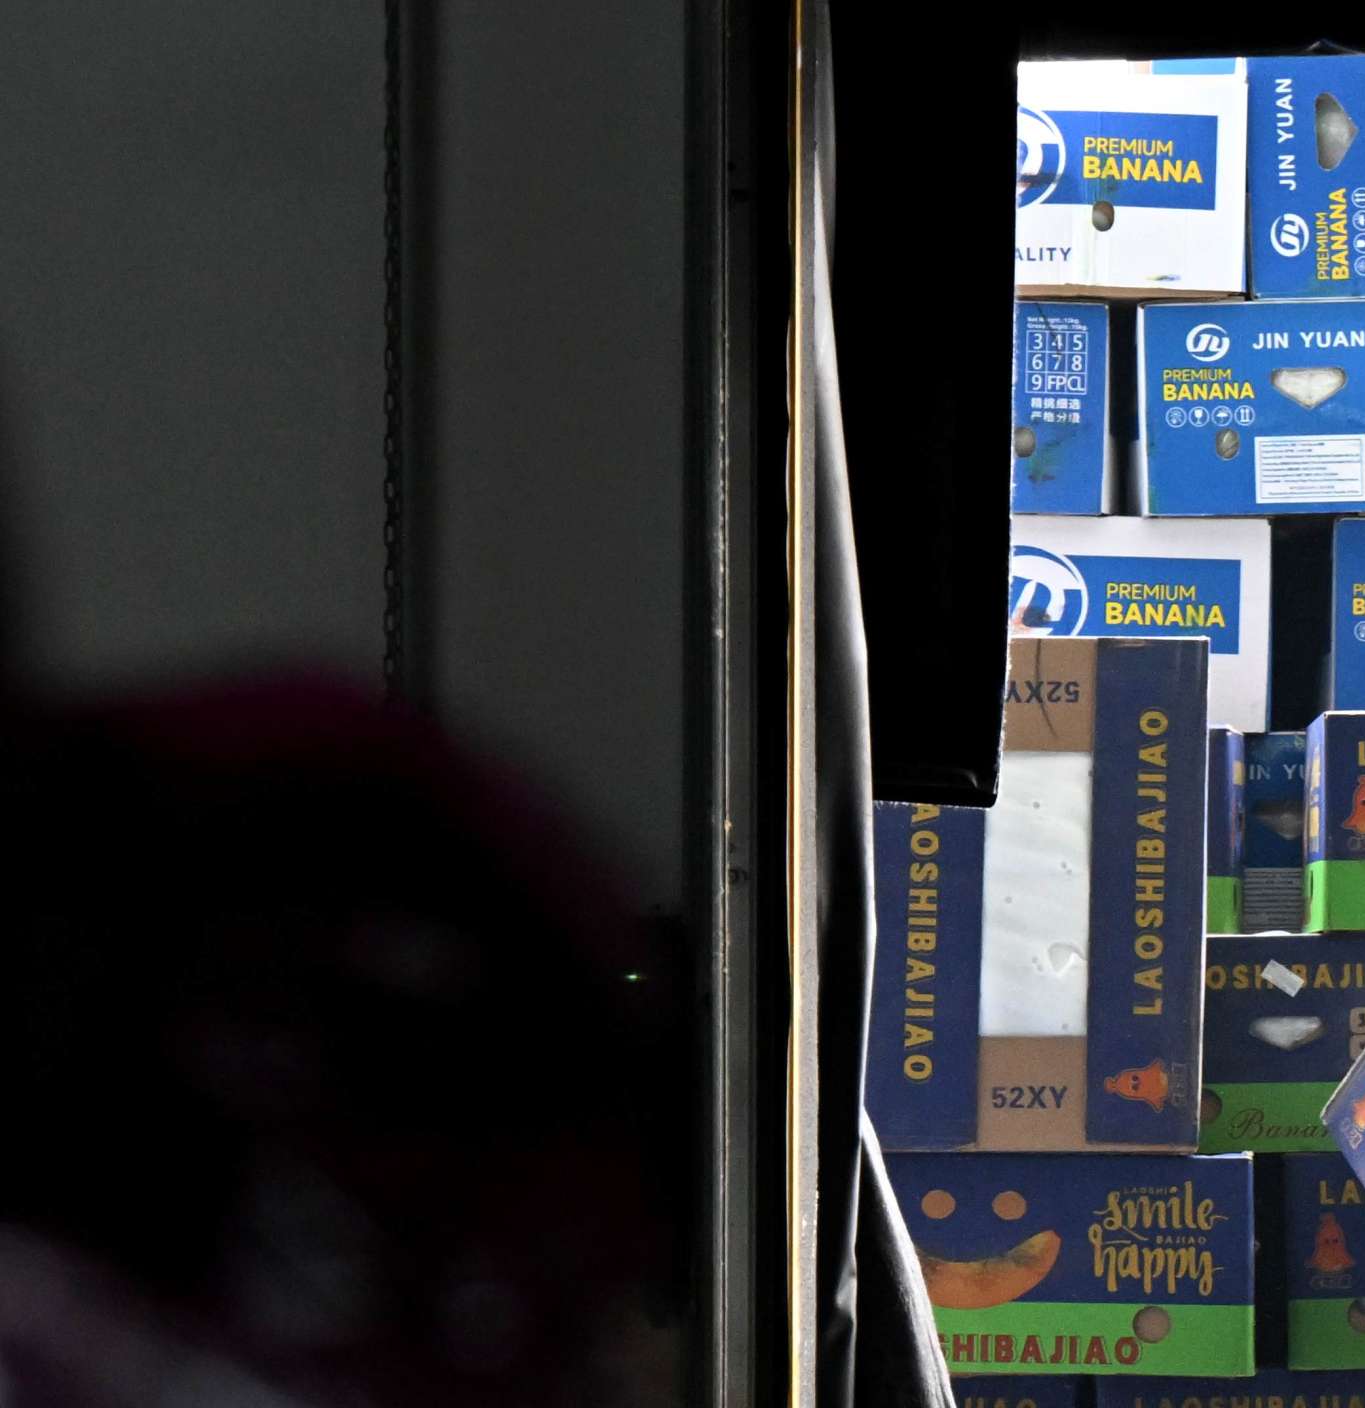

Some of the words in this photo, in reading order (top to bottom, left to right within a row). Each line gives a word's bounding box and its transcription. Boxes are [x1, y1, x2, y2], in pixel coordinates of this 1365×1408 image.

[1275, 77, 1293, 150] YUAN
[1084, 136, 1174, 156] PREMIUM
[1083, 157, 1203, 183] BANANA
[1276, 154, 1296, 190] JIN
[1332, 188, 1350, 280] BANANA
[1015, 247, 1072, 263] ALITY
[1316, 212, 1328, 279] PREMIUM
[1033, 332, 1043, 350] 3
[1072, 332, 1082, 351] 5
[1252, 331, 1291, 349] JIN
[1301, 330, 1365, 349] YUAN
[1032, 352, 1043, 370] 6
[1053, 352, 1063, 370] 7
[1072, 354, 1082, 371] 8
[1031, 373, 1041, 390] 9
[1163, 368, 1233, 382] PREMIUM
[1163, 382, 1255, 401] BANANA
[1106, 582, 1196, 601] PREMIUM
[1105, 602, 1225, 627] BANANA
[1008, 680, 1080, 702] 52XY
[1133, 706, 1170, 1016] LAOSHIBAJIAO
[903, 803, 941, 1082] AOSHIBAJIAO
[992, 1087, 1068, 1109] 52XY
[1093, 1180, 1228, 1242] smile
[1156, 1236, 1207, 1245] BAJIAO
[1088, 1224, 1223, 1295] happy
